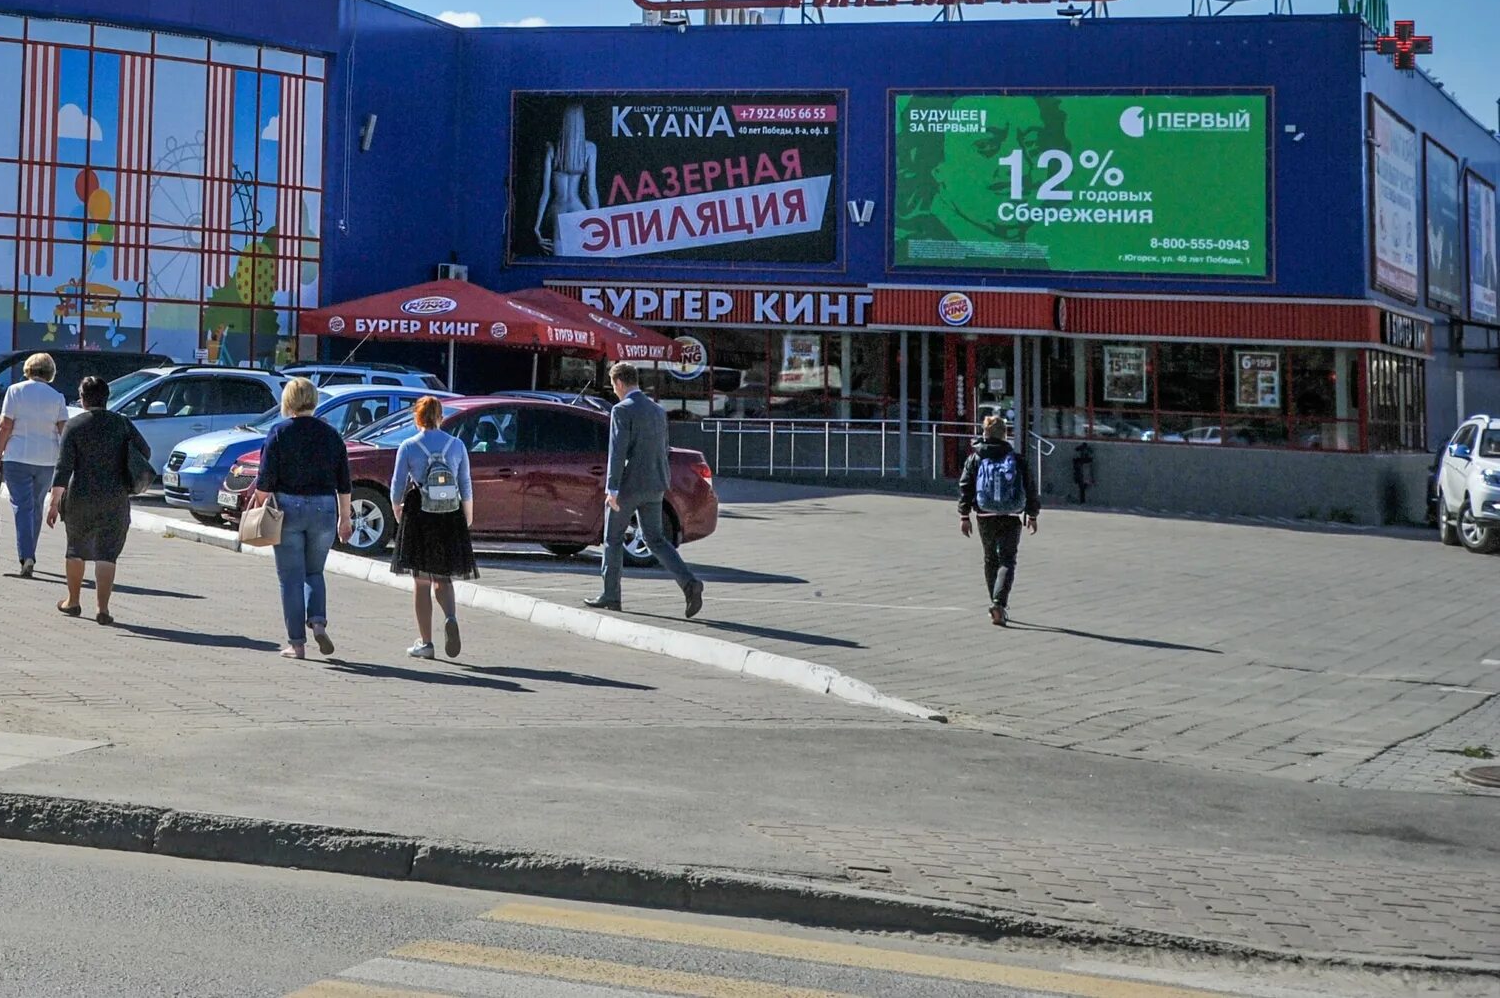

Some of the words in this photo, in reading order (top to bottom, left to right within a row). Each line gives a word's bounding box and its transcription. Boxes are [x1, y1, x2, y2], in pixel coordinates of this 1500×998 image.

[740, 109, 755, 119] +7
[757, 108, 775, 119] 922
[777, 108, 796, 119] 405
[798, 108, 812, 119] 66
[813, 108, 826, 119] 55
[909, 109, 978, 122] БУДУЩЕЕ
[1157, 109, 1250, 128] ПЕРВЫЙ
[762, 127, 794, 136] Победы,
[909, 123, 924, 132] ЗА
[607, 148, 803, 205] ЛАЗЕРНАЯ
[998, 149, 1124, 201] 12%
[1079, 190, 1152, 203] годовых
[579, 188, 807, 252] ЭПИЛЯЦИЯ
[997, 202, 1153, 226] Сбережения
[1150, 238, 1250, 250] 8-800-555-0943
[581, 288, 734, 321] БУРГЕР
[754, 292, 873, 325] КИНГ
[355, 319, 422, 333] БУРГЕР
[429, 321, 479, 336] КИНГ
[625, 344, 648, 357] БУРГЕР
